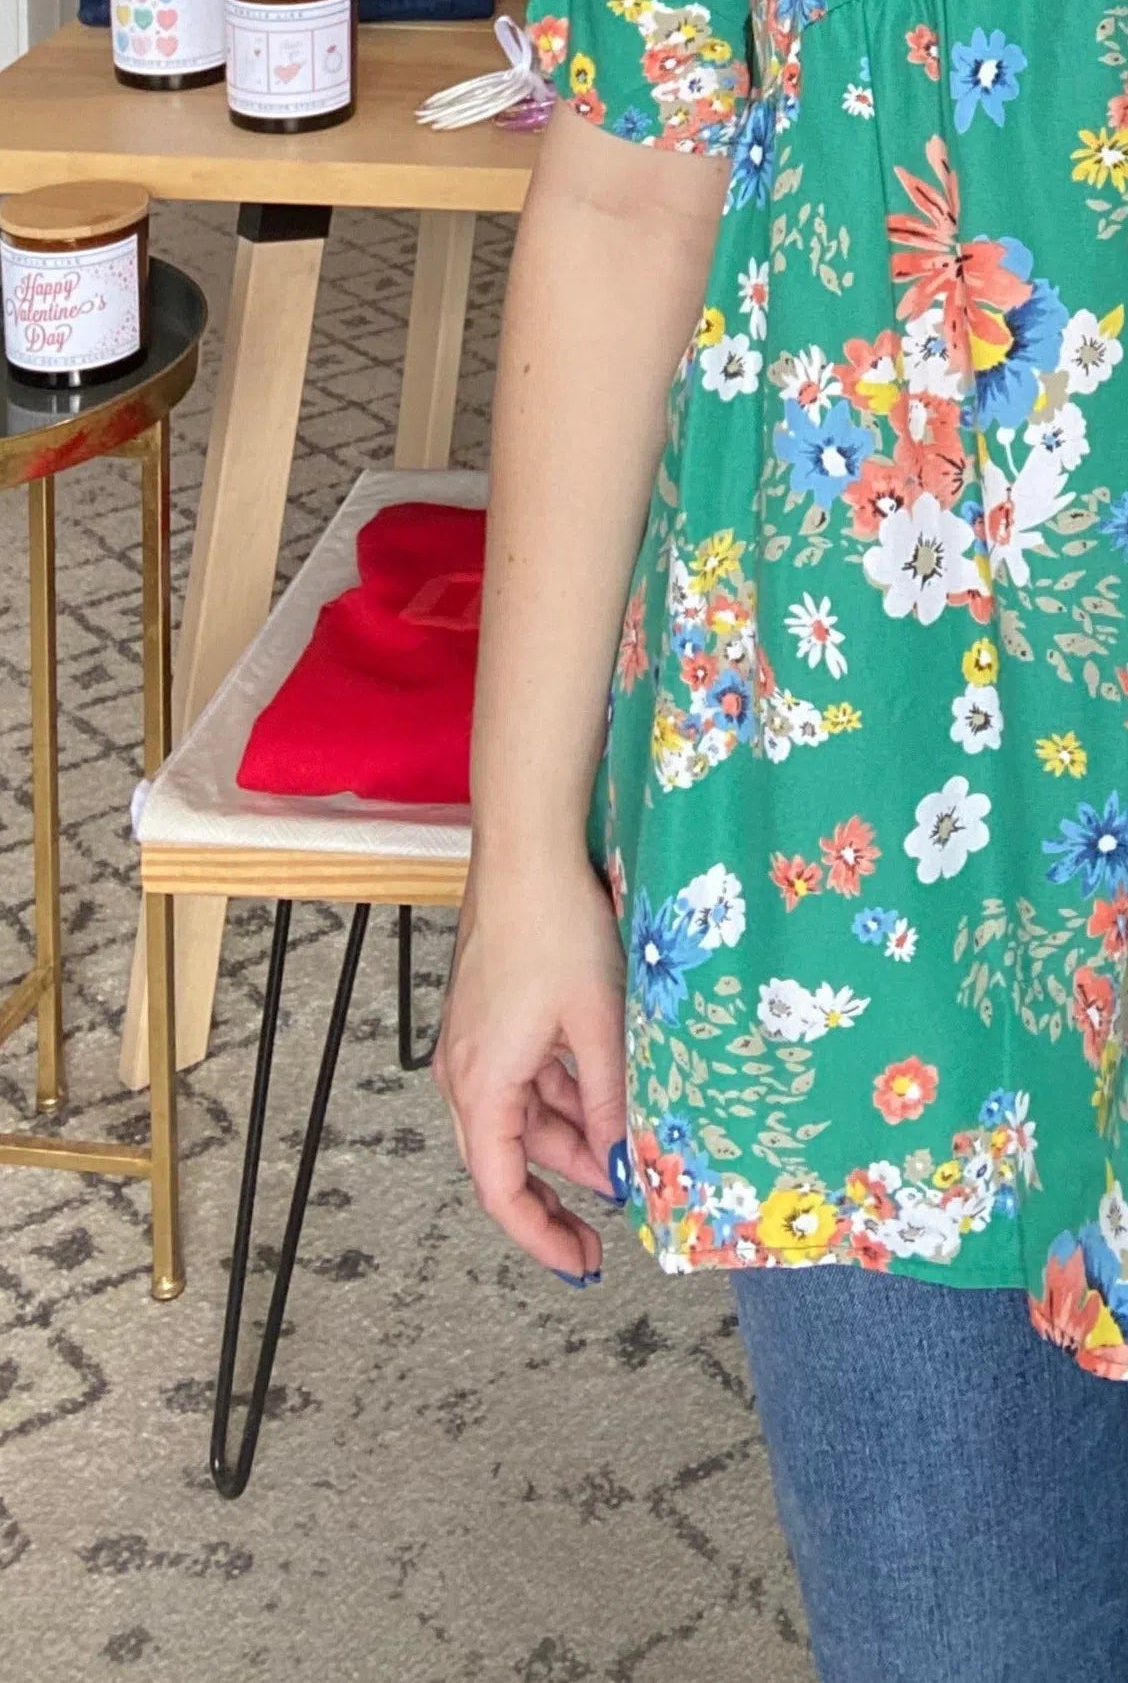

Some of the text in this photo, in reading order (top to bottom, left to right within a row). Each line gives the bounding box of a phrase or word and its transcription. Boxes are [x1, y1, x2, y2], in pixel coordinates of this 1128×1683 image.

[14, 271, 81, 314] Happy
[5, 293, 106, 327] Valentine's
[24, 323, 73, 353] Day
